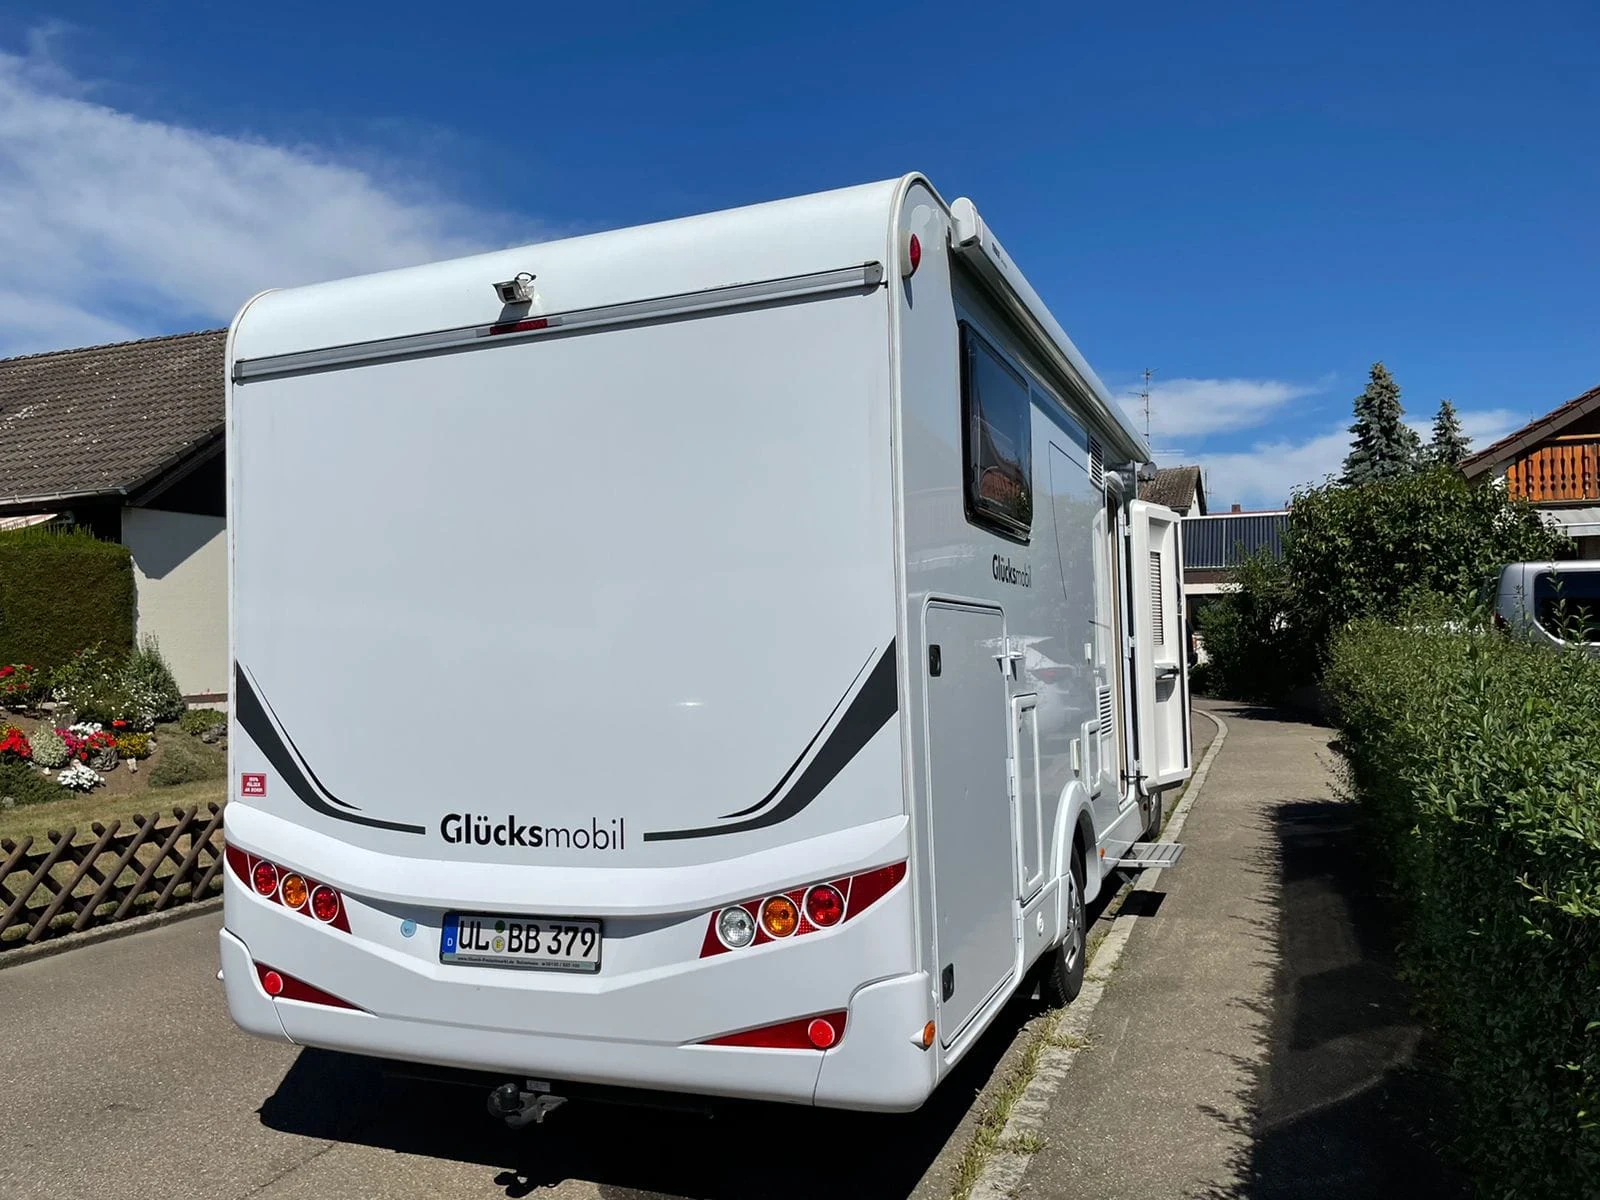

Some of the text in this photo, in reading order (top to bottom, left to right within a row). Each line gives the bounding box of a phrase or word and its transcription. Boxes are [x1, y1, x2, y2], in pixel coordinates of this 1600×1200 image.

[992, 554, 1032, 588] Glücksmobil
[440, 813, 625, 850] Glücksmobil
[447, 937, 453, 947] D
[458, 920, 596, 957] UL BB 379
